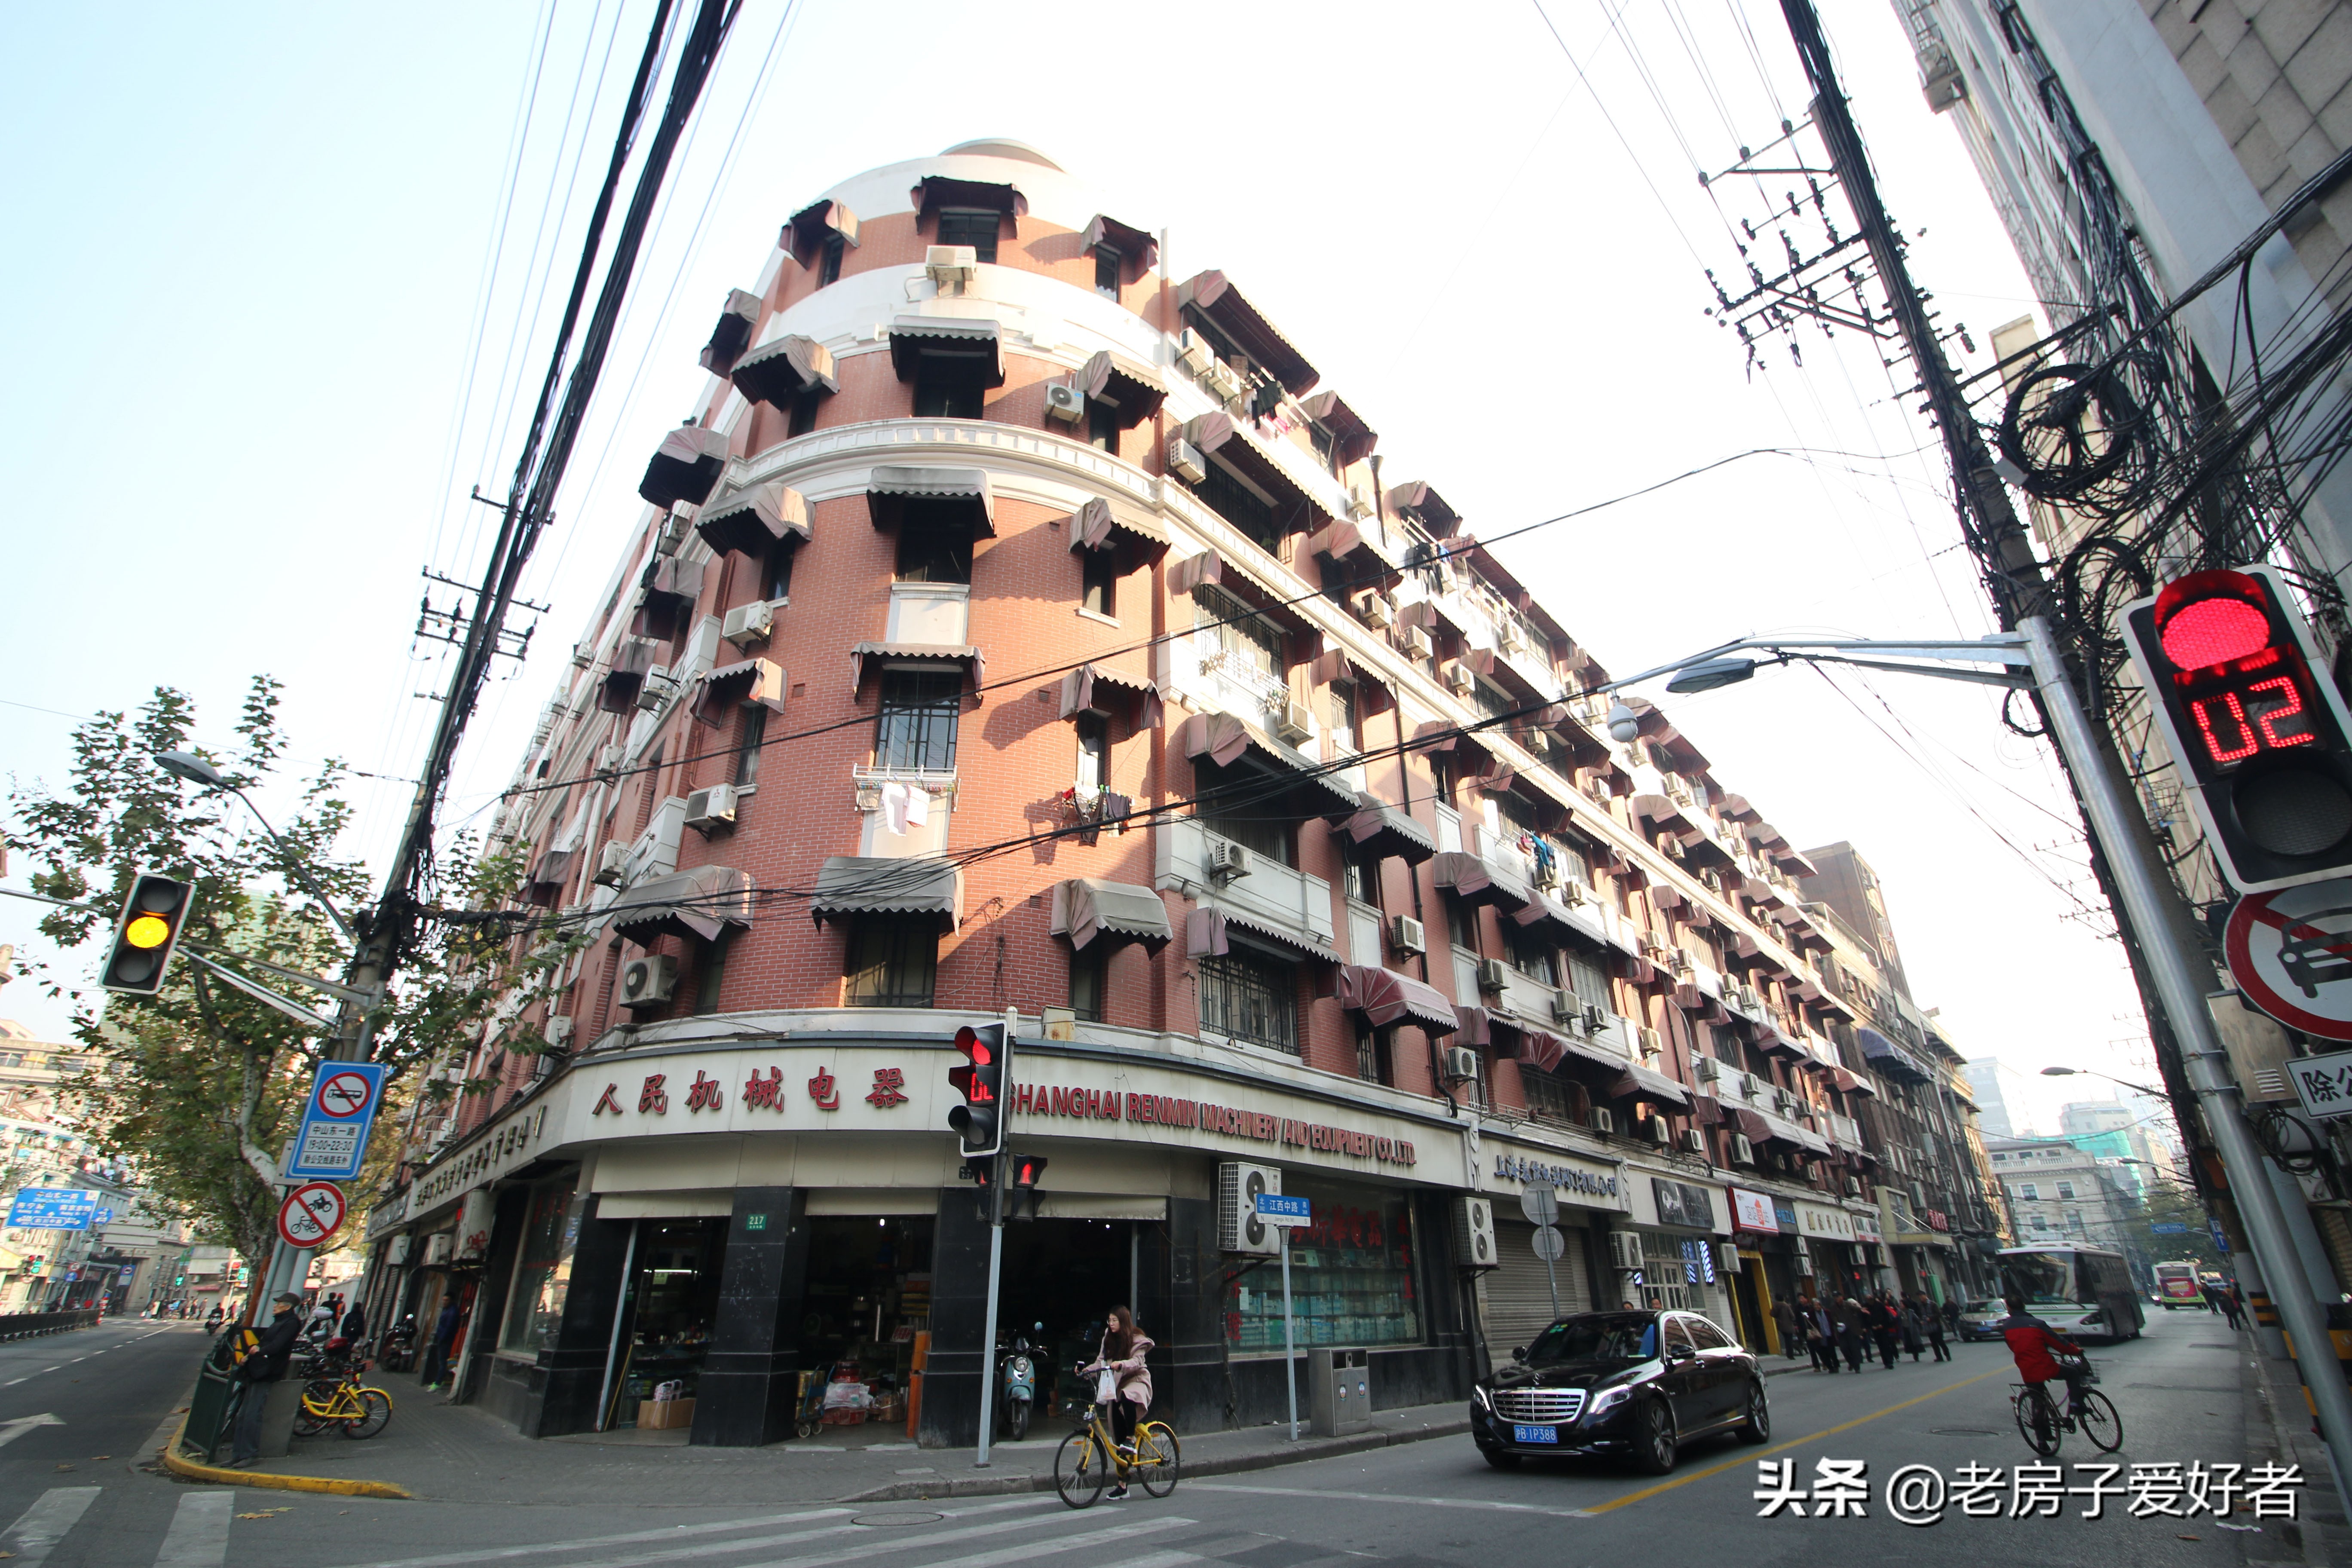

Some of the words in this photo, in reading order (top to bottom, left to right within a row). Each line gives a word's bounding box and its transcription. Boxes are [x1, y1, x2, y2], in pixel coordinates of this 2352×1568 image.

[2192, 676, 2315, 761] 02
[592, 1066, 909, 1115] 人民机械电器
[313, 1125, 356, 1136] 中山东一路
[1126, 1092, 1199, 1128] RENMIN
[1200, 1103, 1281, 1141] MACHINERY
[1283, 1118, 1310, 1146] AND
[1310, 1124, 1375, 1157] EQUIPMENT
[308, 1139, 353, 1151] 19:00-22:30
[303, 1155, 348, 1165] 除公交线路车外
[1269, 1199, 1298, 1213] 江西中路
[749, 1216, 764, 1225] 217
